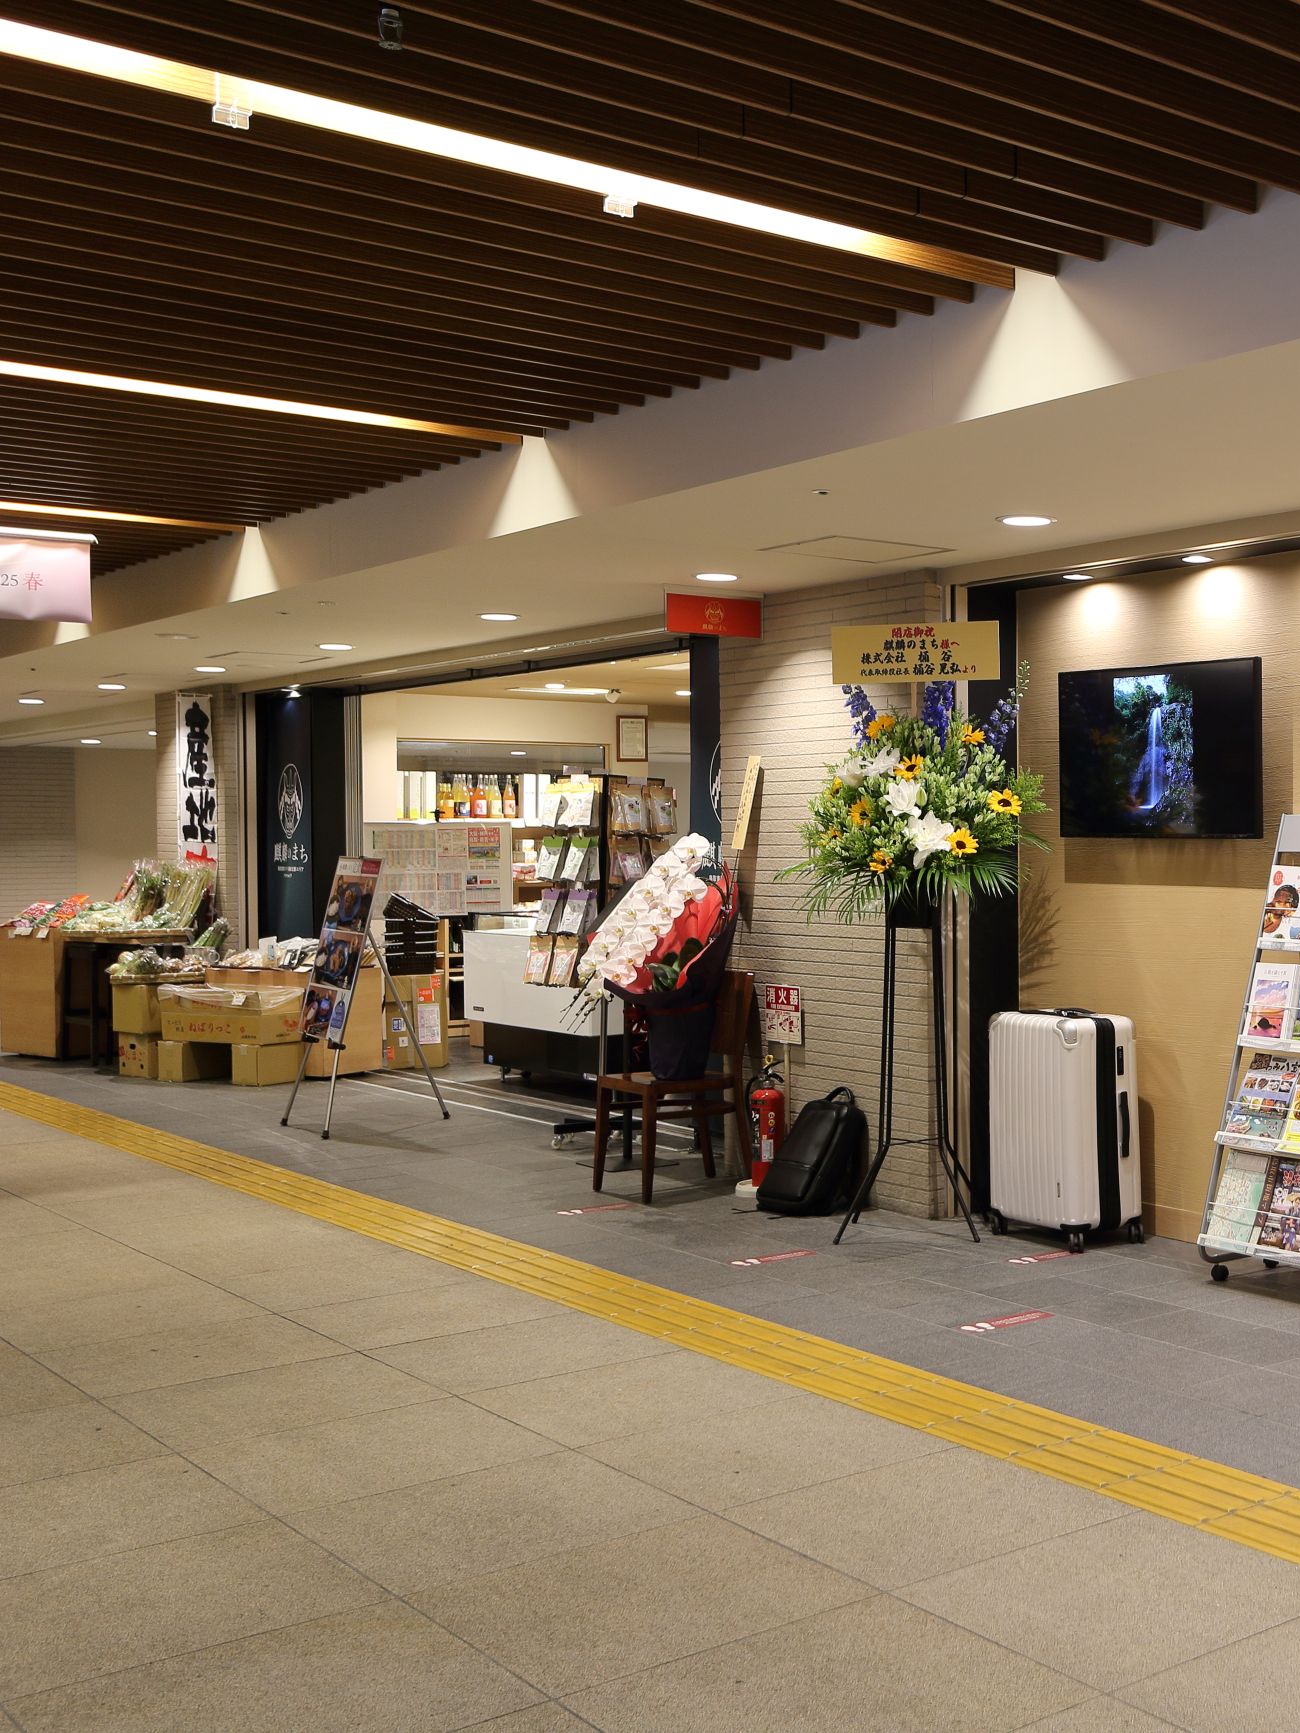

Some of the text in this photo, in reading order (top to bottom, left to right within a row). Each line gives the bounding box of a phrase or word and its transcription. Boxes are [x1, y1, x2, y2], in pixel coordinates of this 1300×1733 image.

[22, 571, 44, 591] 春
[861, 652, 906, 665] 株式会社
[766, 986, 799, 1006] 消火器
